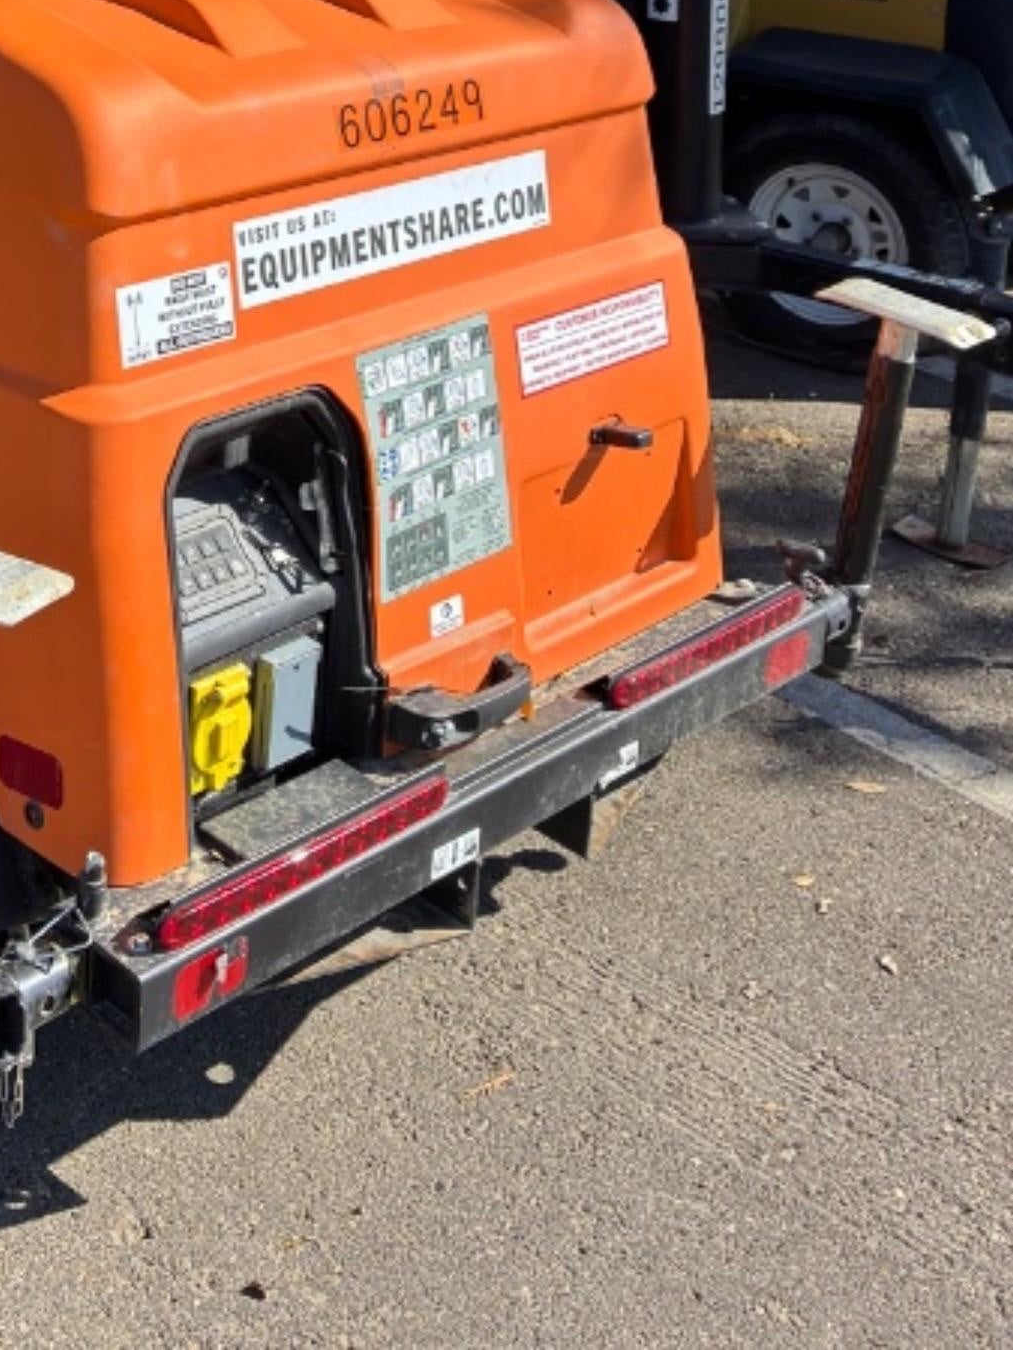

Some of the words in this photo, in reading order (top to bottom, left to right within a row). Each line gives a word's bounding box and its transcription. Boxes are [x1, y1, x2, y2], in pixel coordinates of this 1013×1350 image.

[340, 79, 483, 148] 606249
[239, 221, 279, 247] VISIT
[287, 215, 306, 234] US
[242, 183, 546, 295] EQUIPMENTSHARE.COM
